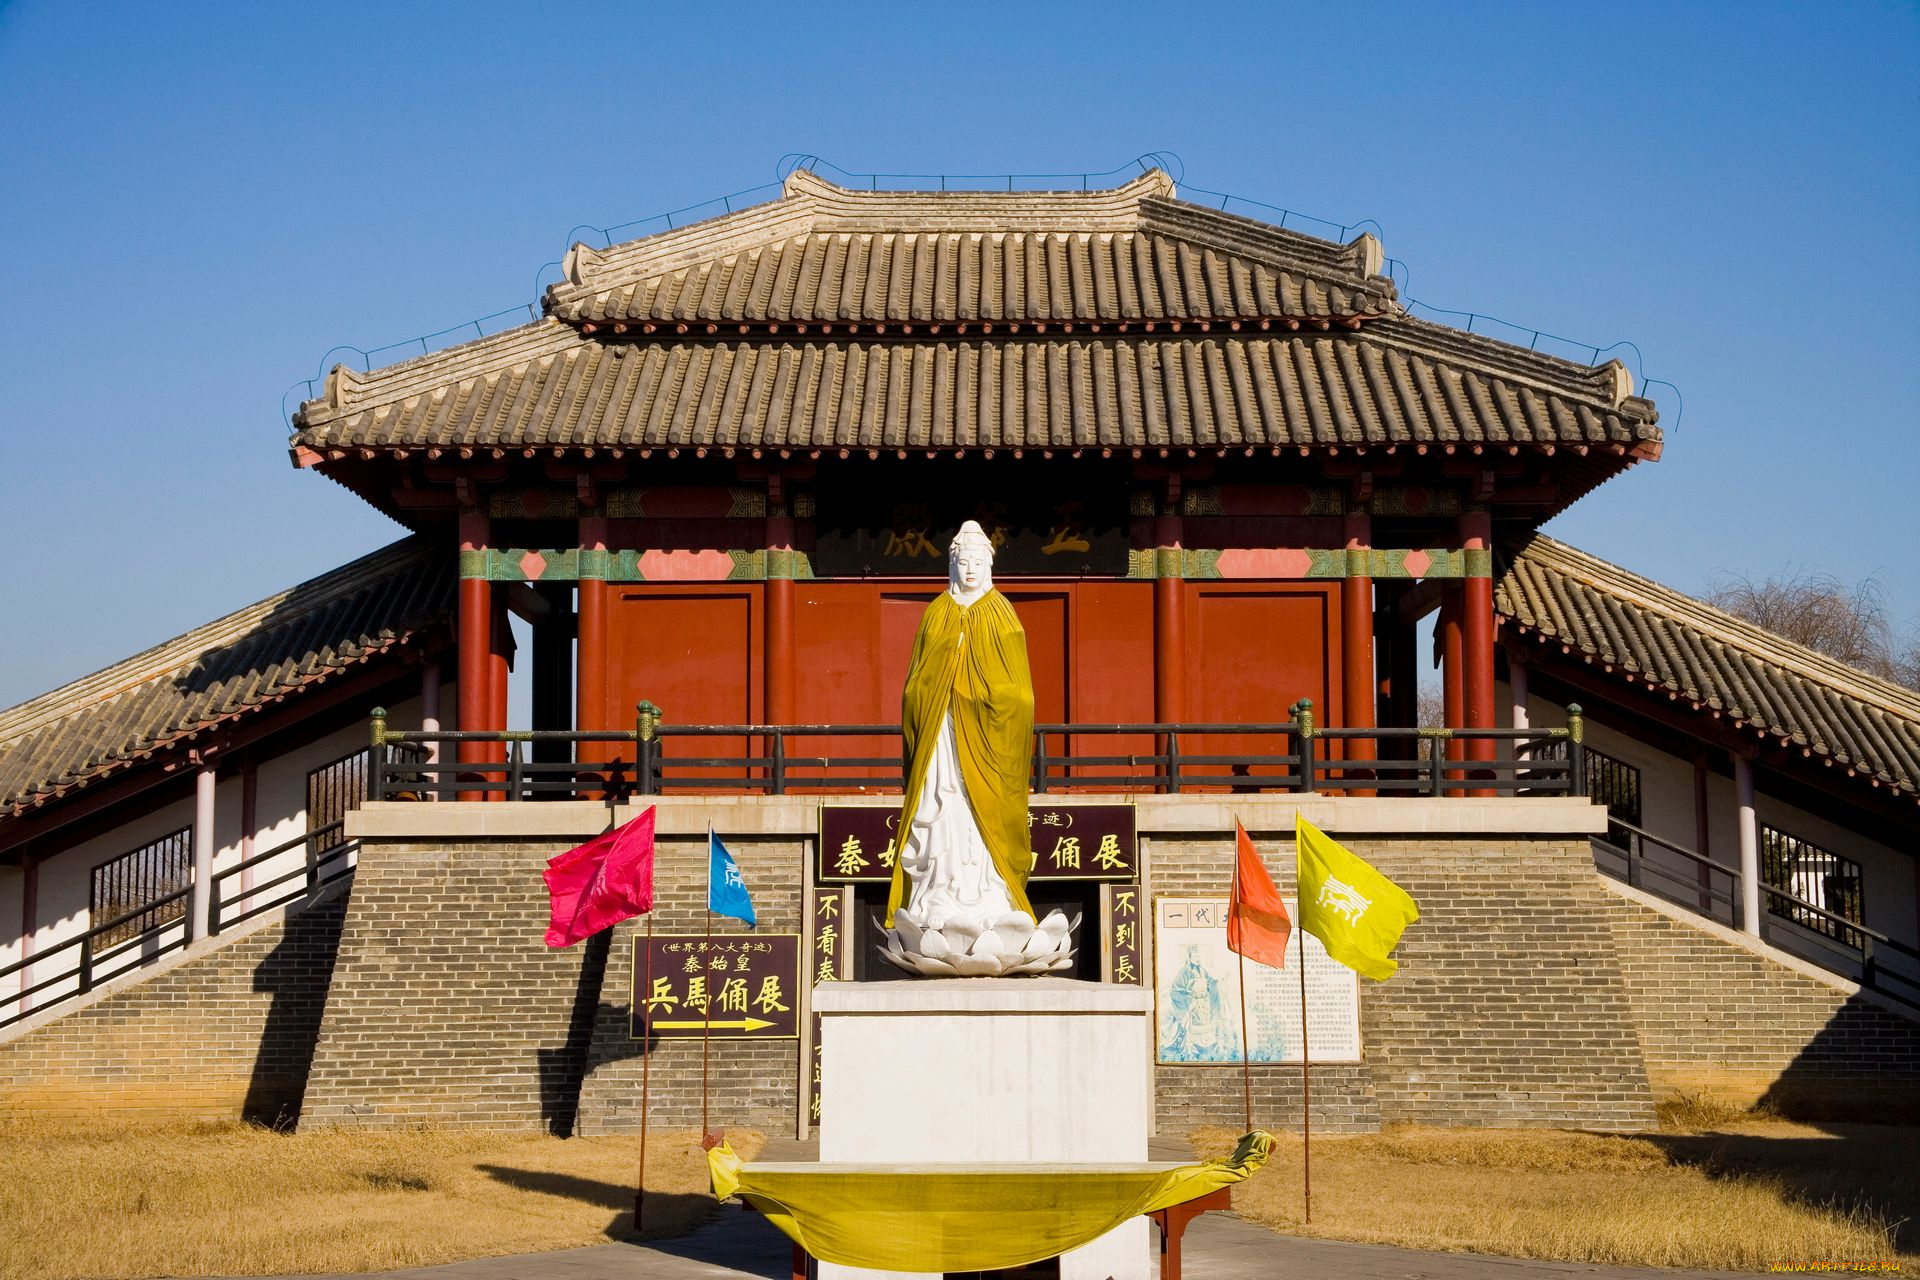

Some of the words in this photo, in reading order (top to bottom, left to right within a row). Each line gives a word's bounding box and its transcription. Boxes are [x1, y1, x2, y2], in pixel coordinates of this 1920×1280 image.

[1031, 834, 1129, 871] 俑展
[682, 953, 751, 973] 秦始皇
